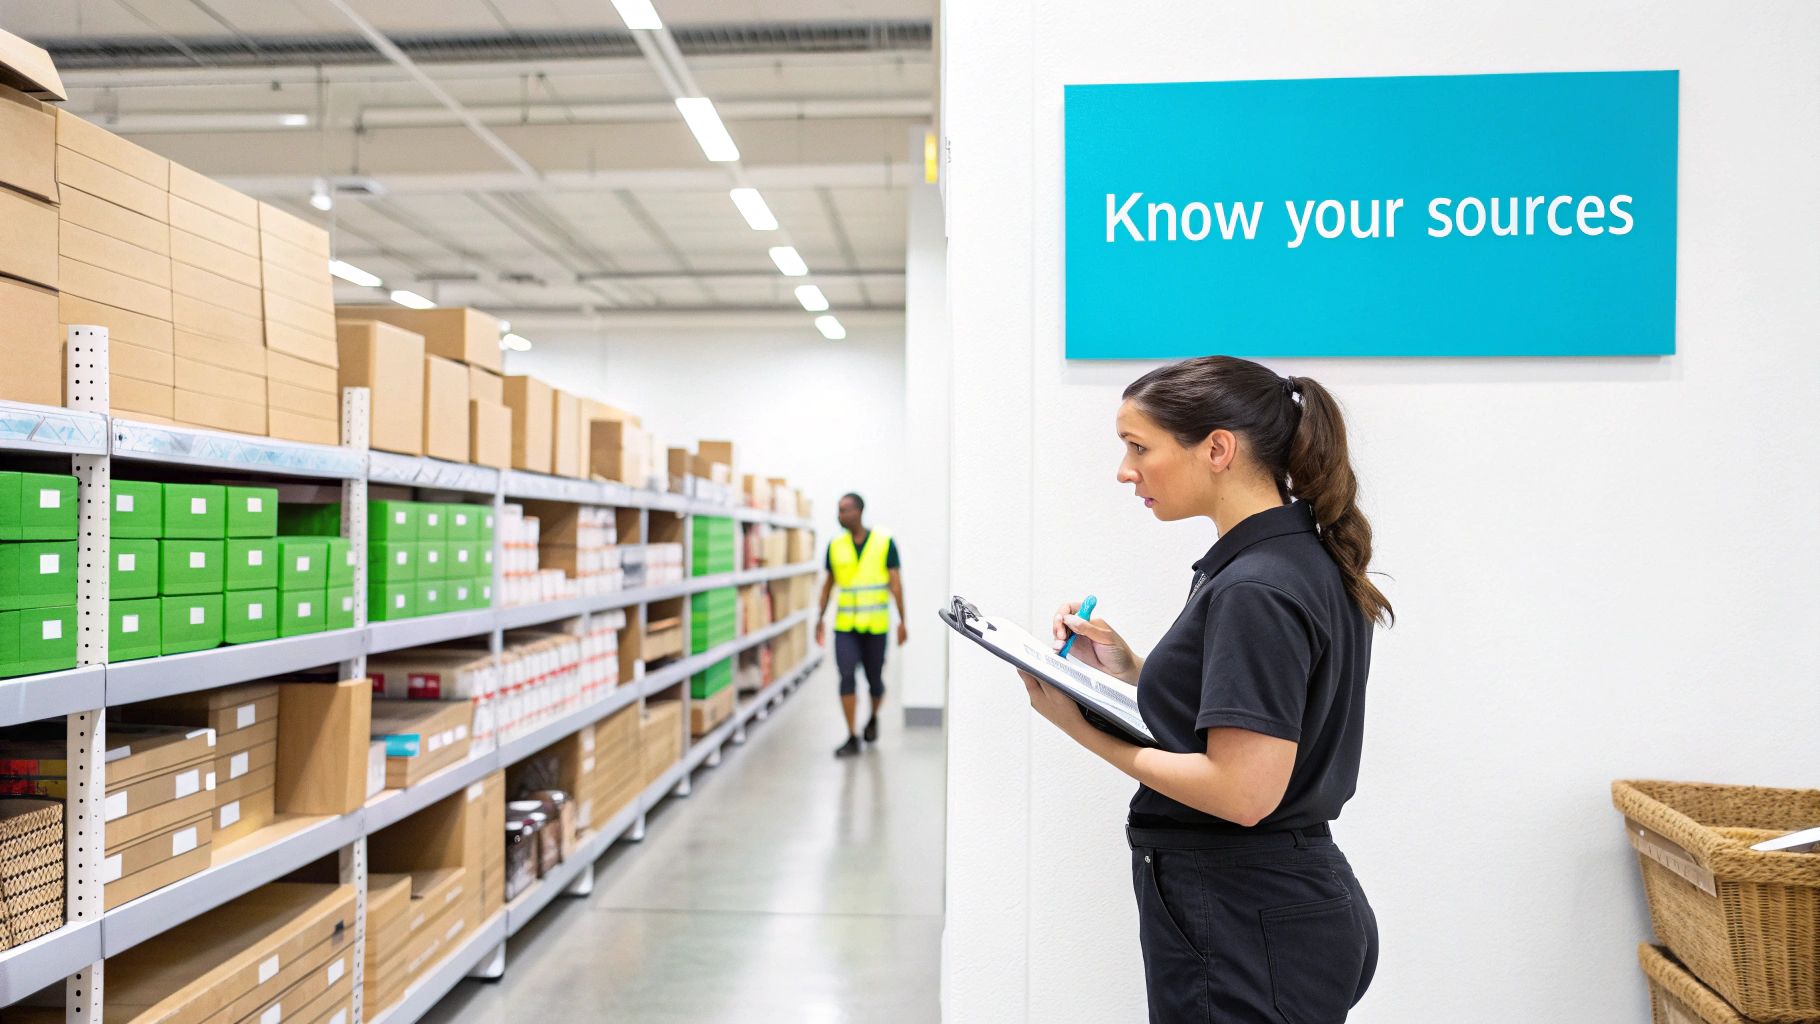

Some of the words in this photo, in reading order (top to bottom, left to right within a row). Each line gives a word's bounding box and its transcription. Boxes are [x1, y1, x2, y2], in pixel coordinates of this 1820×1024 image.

[1106, 192, 1263, 243] Know
[1285, 198, 1404, 249] your
[1427, 193, 1634, 238] sources
